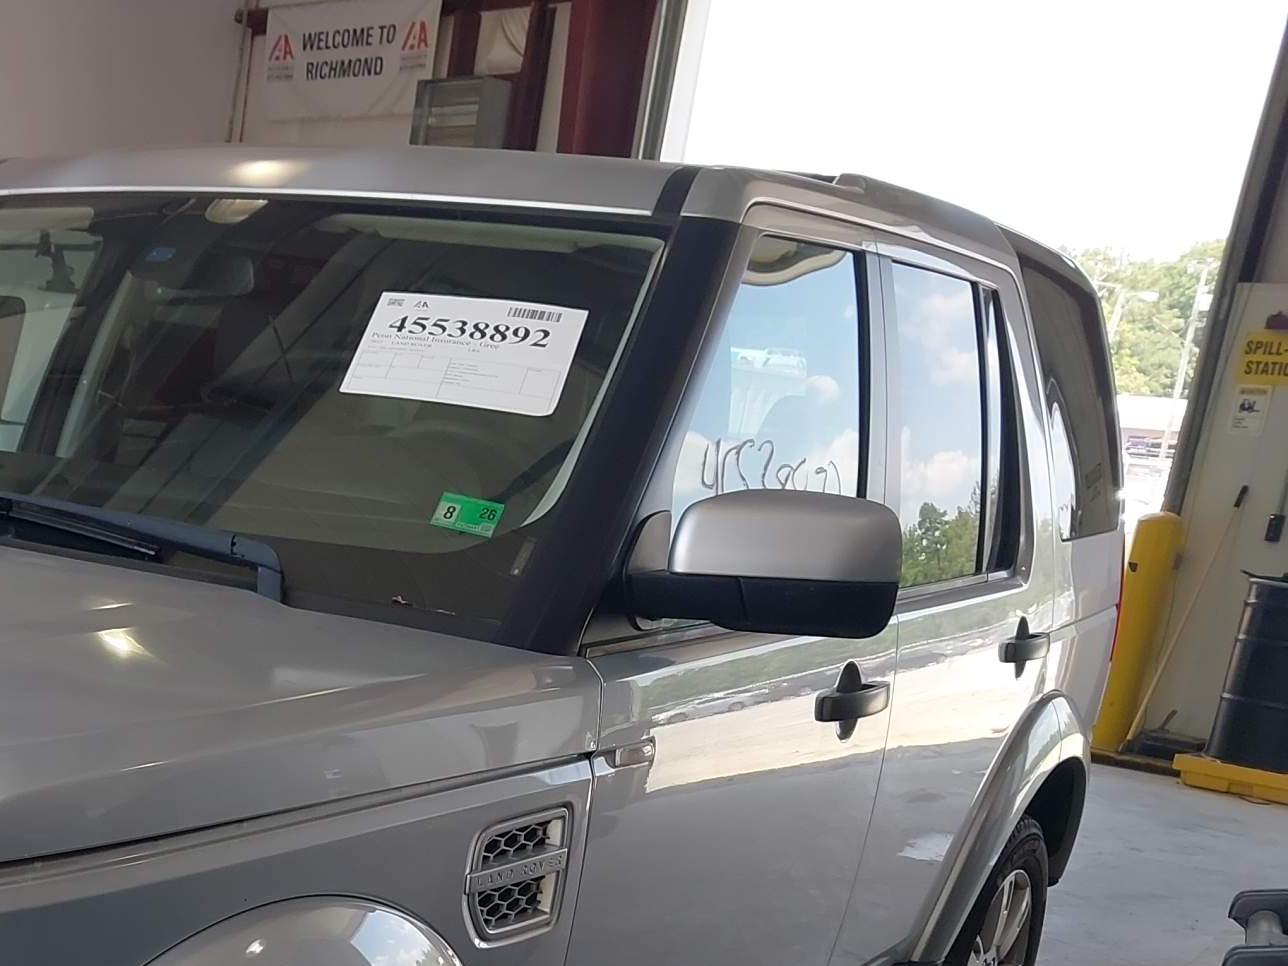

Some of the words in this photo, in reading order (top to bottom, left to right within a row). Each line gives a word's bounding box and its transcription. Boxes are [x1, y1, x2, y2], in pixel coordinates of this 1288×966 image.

[302, 26, 374, 51] WELCOME
[378, 24, 397, 45] TO
[305, 56, 384, 81] RICHMOND
[388, 315, 551, 348] 45538892
[443, 505, 457, 520] 8
[479, 507, 498, 521] 26
